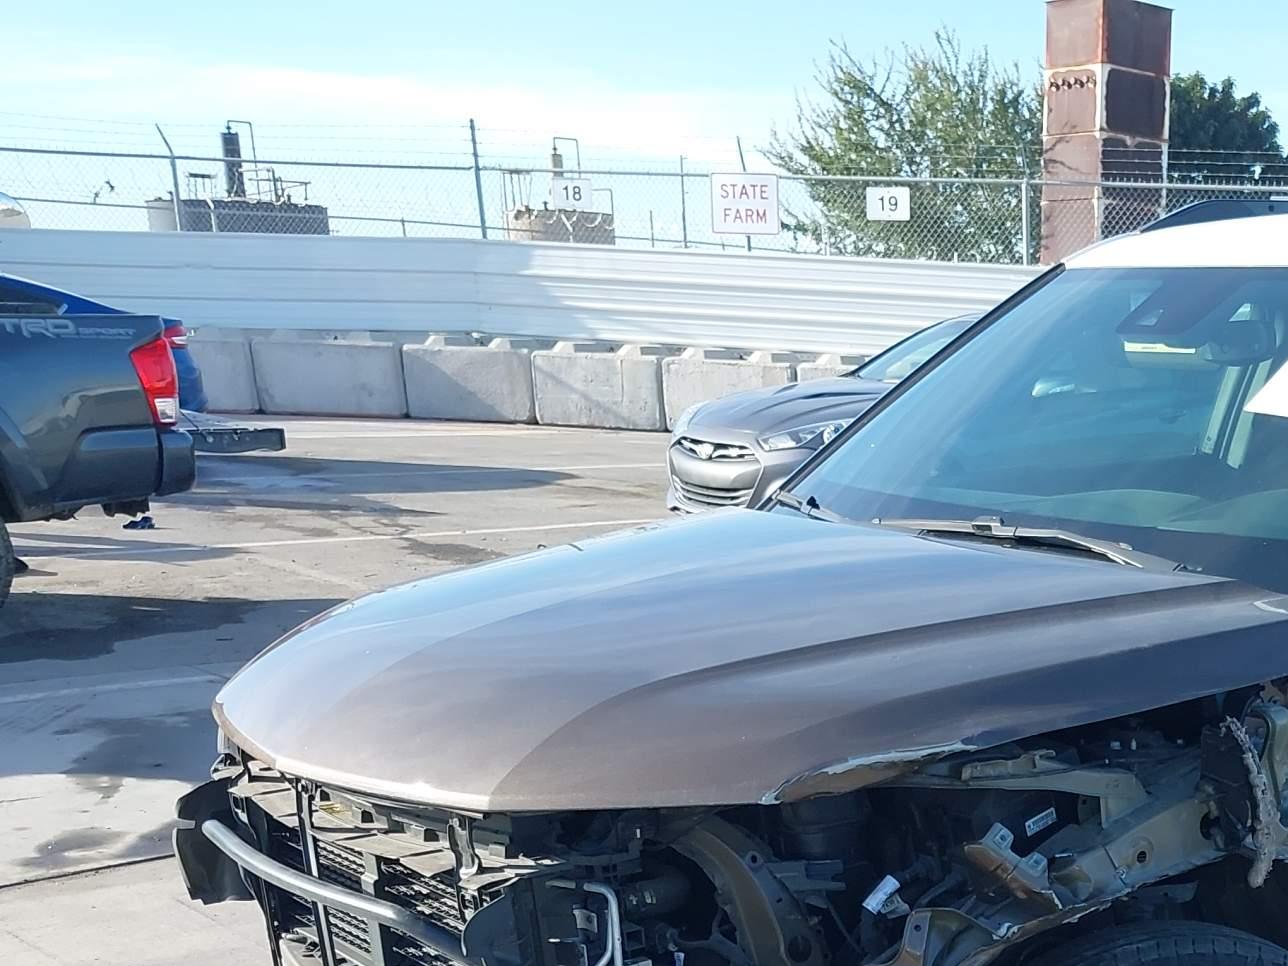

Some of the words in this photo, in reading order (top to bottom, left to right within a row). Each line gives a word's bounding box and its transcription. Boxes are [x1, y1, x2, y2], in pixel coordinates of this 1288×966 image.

[562, 185, 582, 201] 18
[720, 183, 769, 200] STATE
[878, 195, 898, 212] 19
[723, 207, 767, 224] FARM
[78, 326, 137, 339] SPORT
